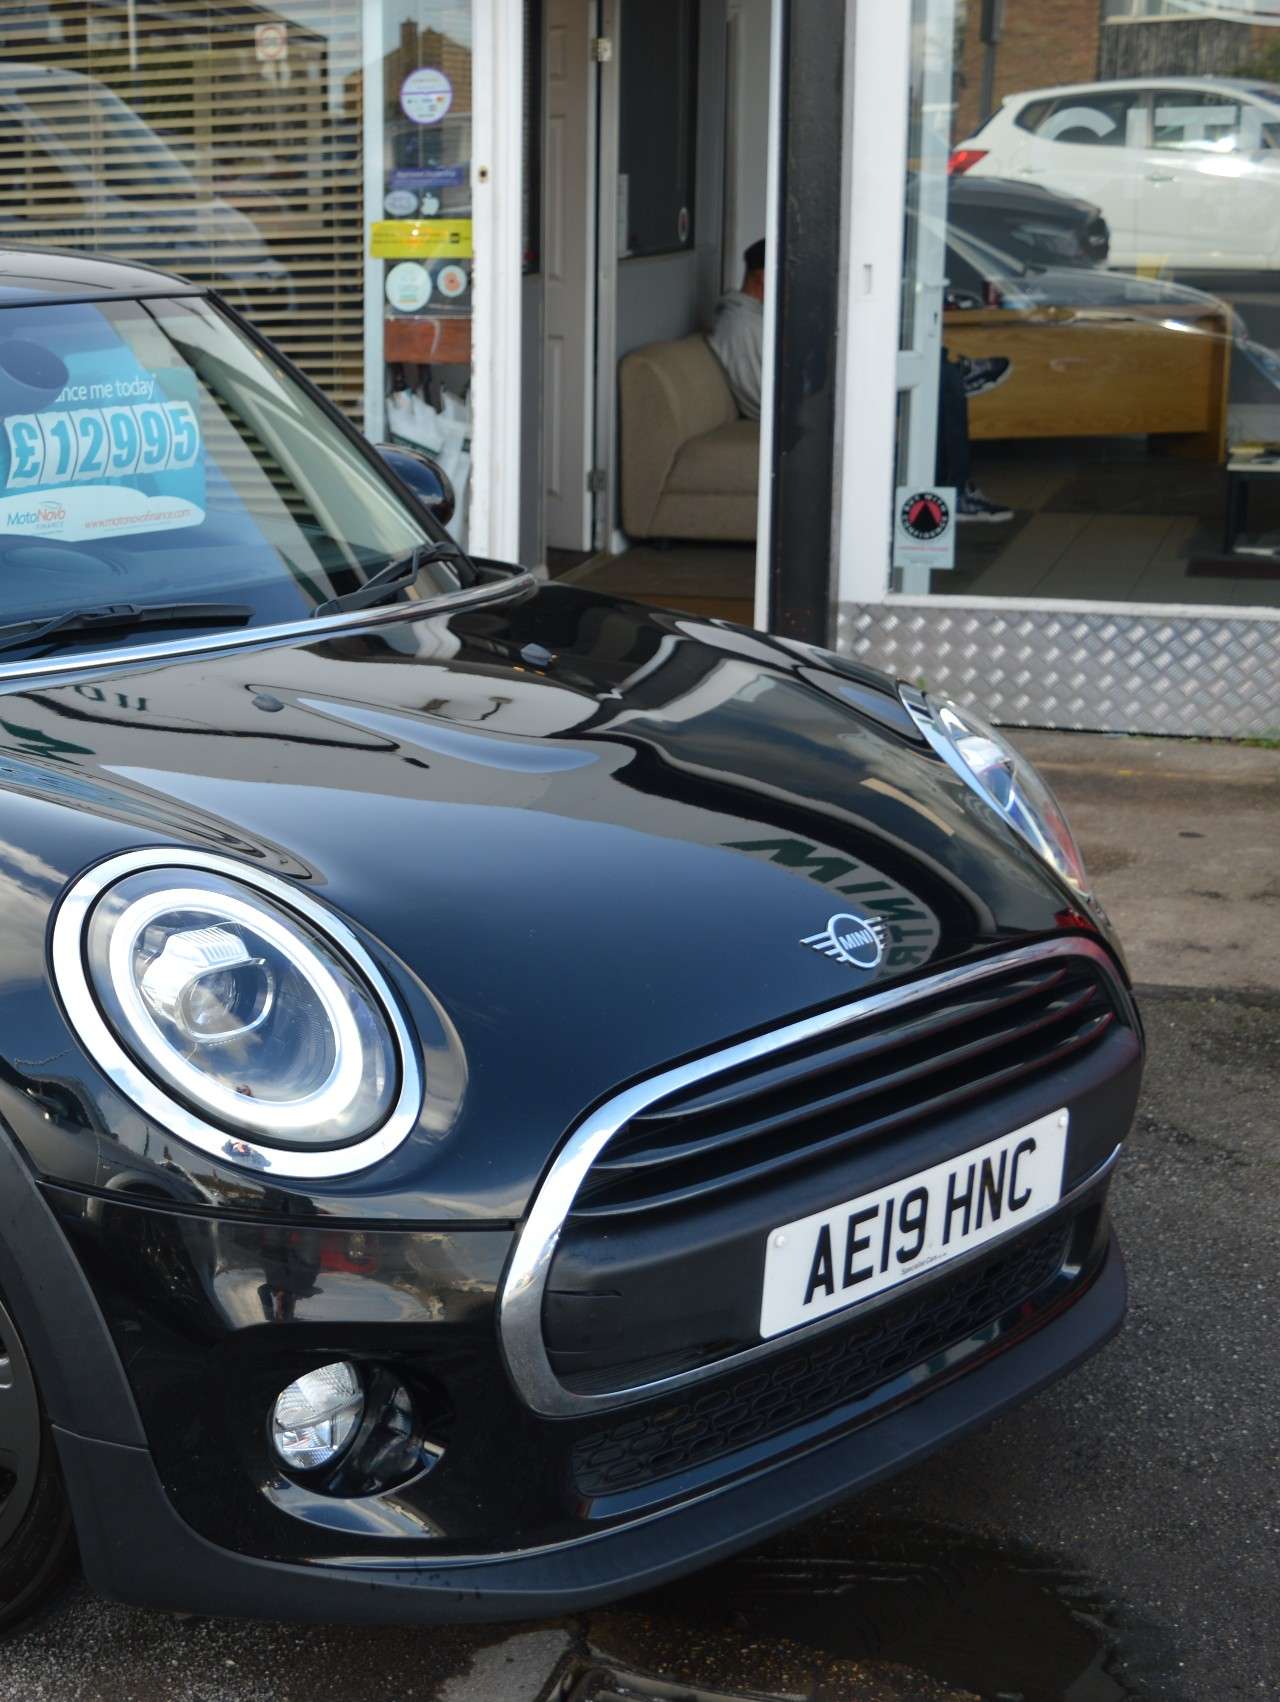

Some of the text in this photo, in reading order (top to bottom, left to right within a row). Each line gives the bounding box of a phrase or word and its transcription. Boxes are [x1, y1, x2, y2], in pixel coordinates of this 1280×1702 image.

[90, 383, 113, 399] me
[116, 375, 154, 401] today
[12, 408, 198, 480] £12995
[7, 507, 66, 527] MotoNovo
[838, 928, 874, 950] MINI
[803, 1137, 1036, 1305] AE19 HNC
